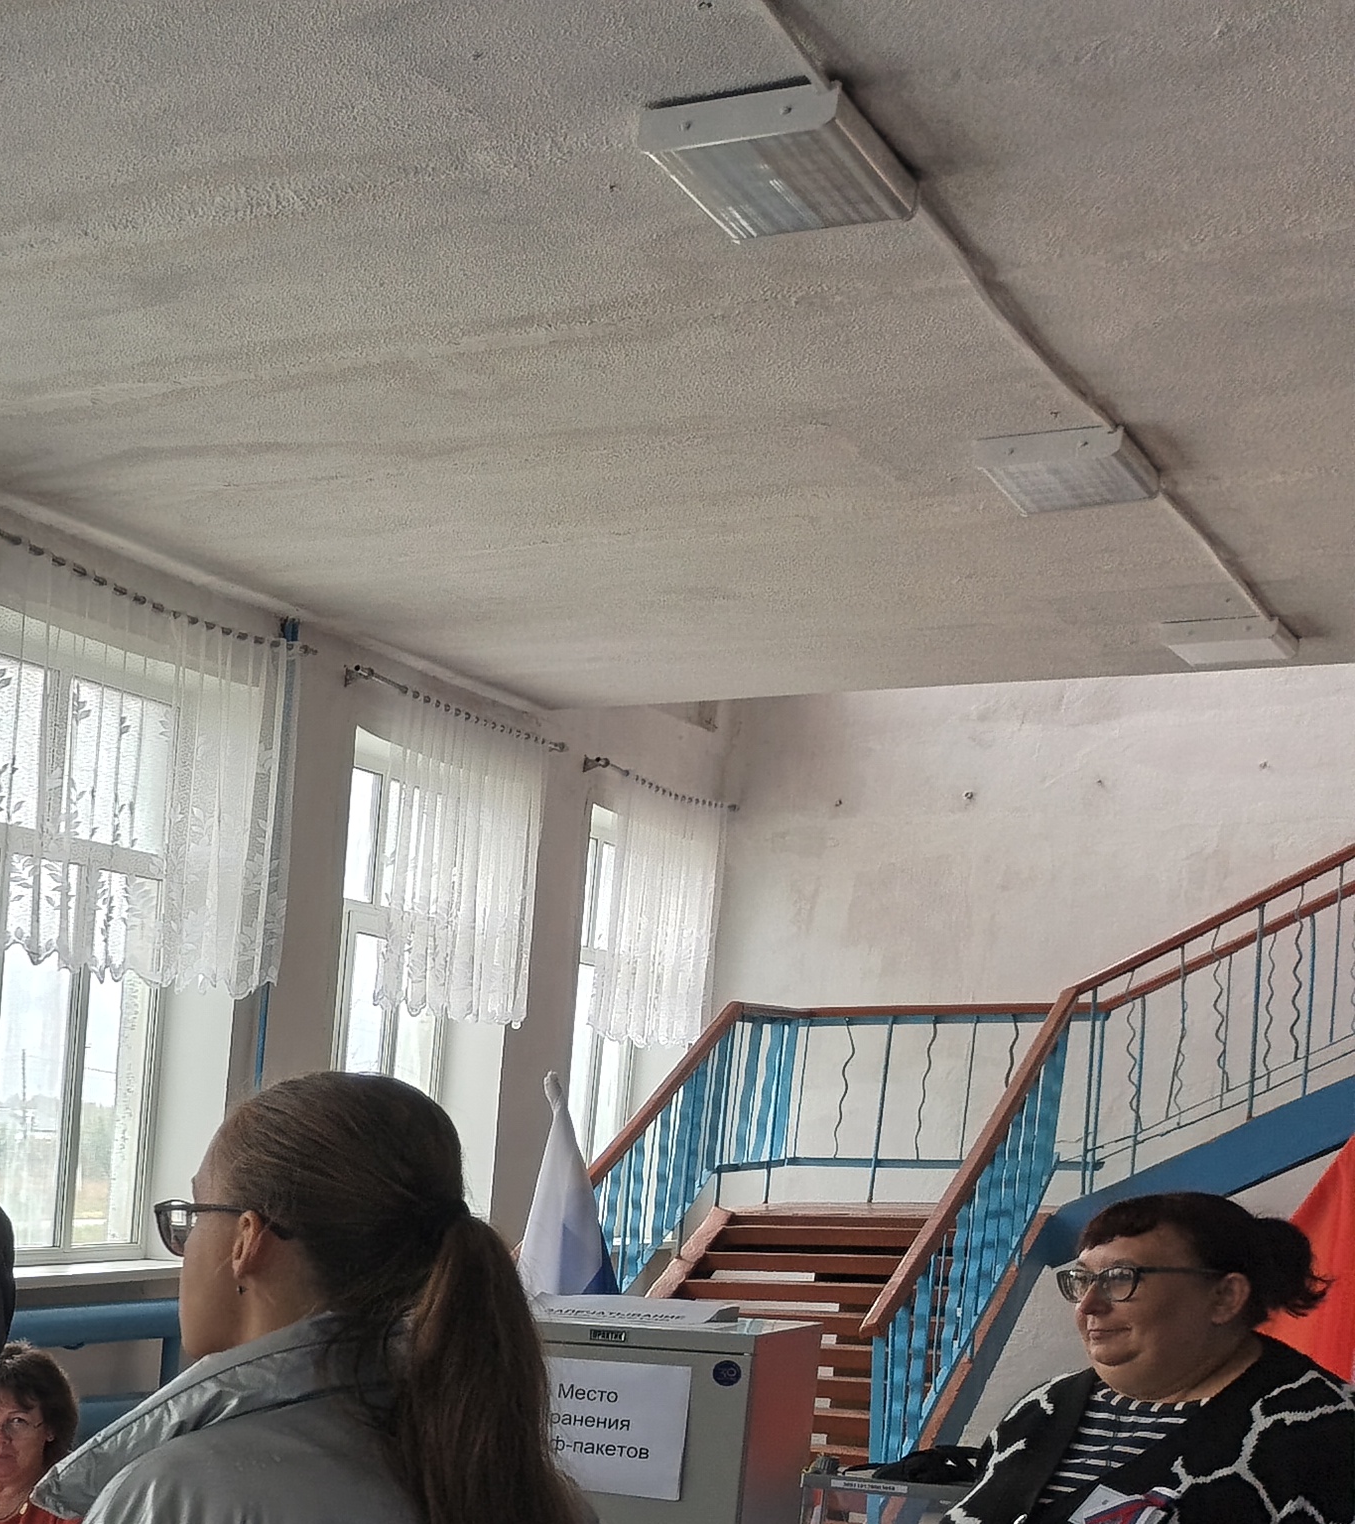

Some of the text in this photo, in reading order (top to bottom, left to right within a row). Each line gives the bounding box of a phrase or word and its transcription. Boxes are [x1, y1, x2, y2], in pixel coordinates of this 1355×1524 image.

[557, 1383, 618, 1403] Место
[549, 1412, 631, 1431] ранения
[550, 1435, 650, 1460] ф-пакетов
